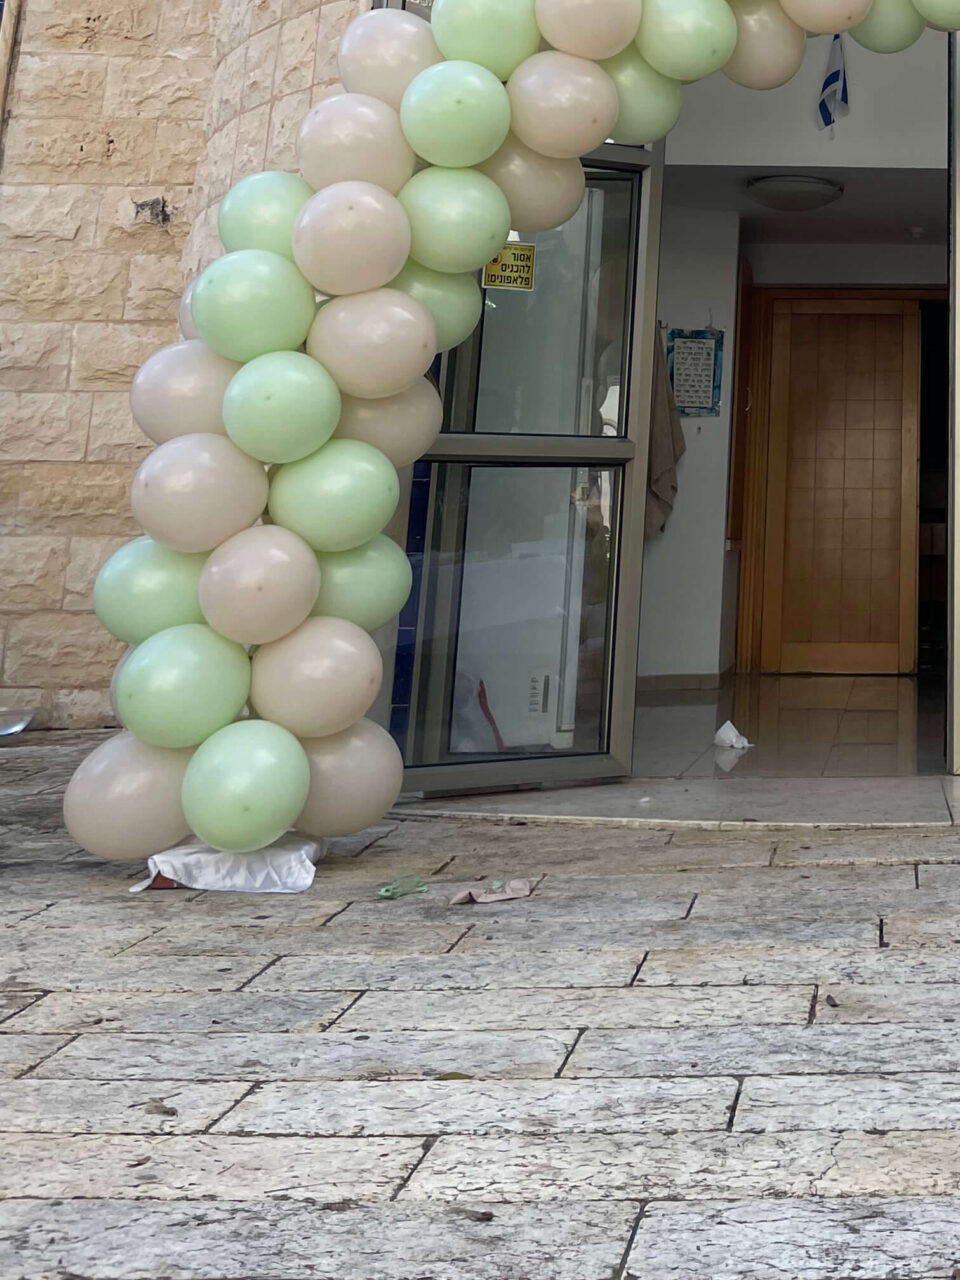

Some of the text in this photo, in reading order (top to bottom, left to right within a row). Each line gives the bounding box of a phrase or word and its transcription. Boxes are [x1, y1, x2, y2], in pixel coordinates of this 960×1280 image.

[511, 252, 531, 263] אסור
[501, 263, 531, 274] להכניס
[487, 273, 530, 286] פלאפונים!
